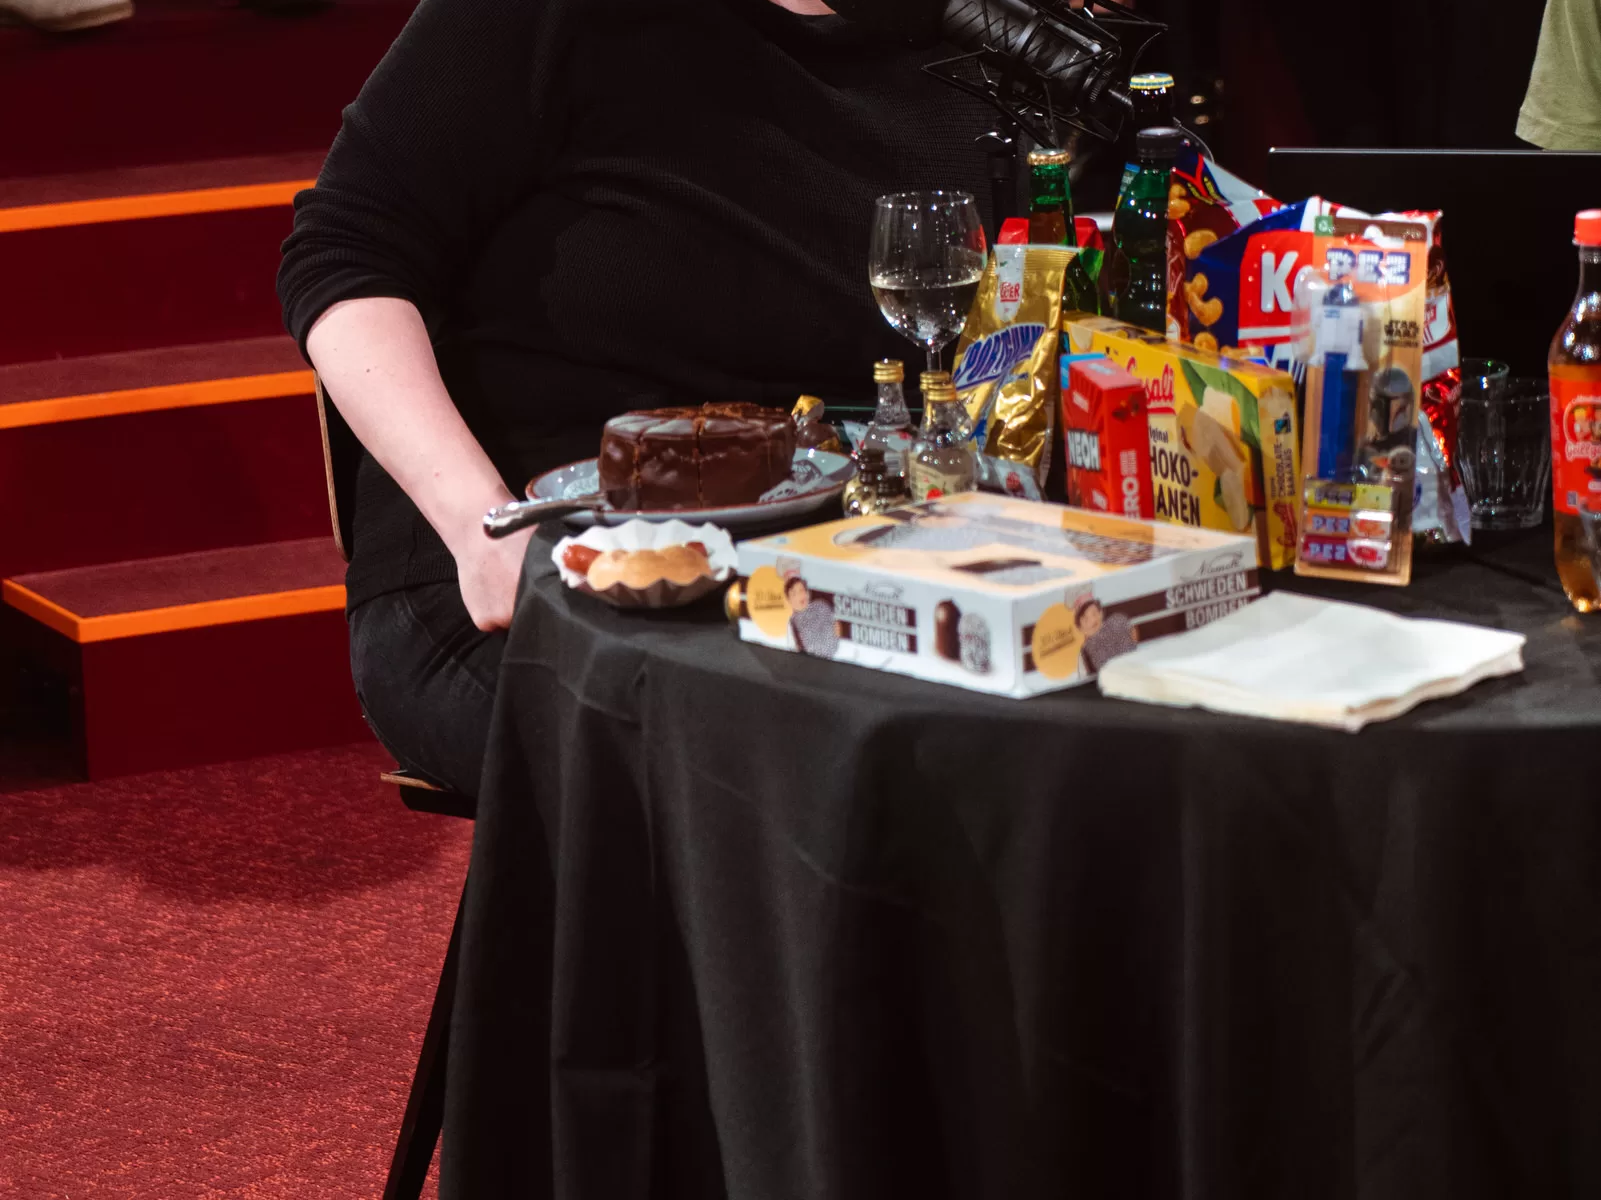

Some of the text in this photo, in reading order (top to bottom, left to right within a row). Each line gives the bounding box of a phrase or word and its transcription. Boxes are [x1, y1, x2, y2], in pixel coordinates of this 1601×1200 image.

[1326, 248, 1411, 286] PEZ
[1067, 430, 1100, 471] NEOH
[1311, 515, 1350, 533] PEZ
[1308, 543, 1347, 561] PEZ
[1165, 573, 1247, 610] SCHWEDEN
[832, 594, 910, 625] SCHWEDEN
[851, 623, 910, 652] BOMBEN
